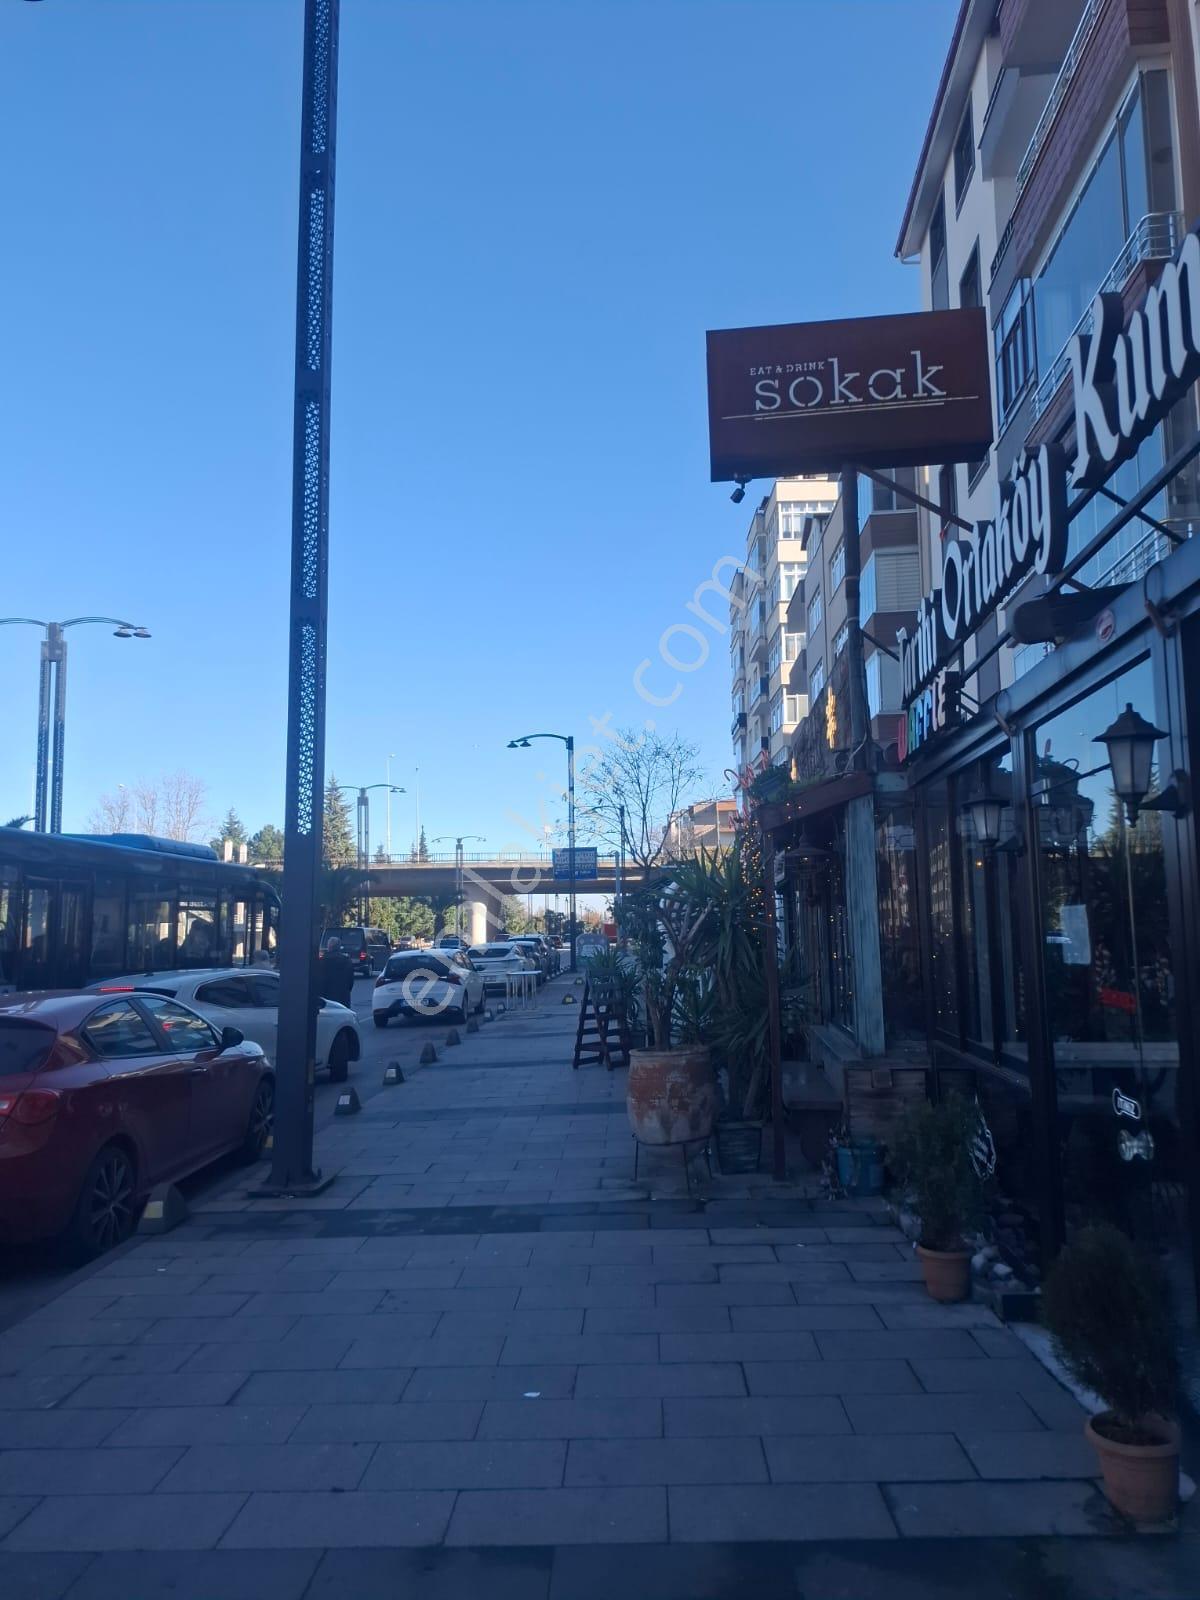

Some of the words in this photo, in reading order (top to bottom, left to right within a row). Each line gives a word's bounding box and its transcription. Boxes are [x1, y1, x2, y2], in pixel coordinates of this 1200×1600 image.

[750, 365, 772, 376] EAT
[776, 365, 783, 374] &
[786, 361, 825, 373] DRINK
[755, 350, 947, 411] sokak
[896, 589, 938, 711] Tarihi
[941, 445, 1050, 640] Ortaköy
